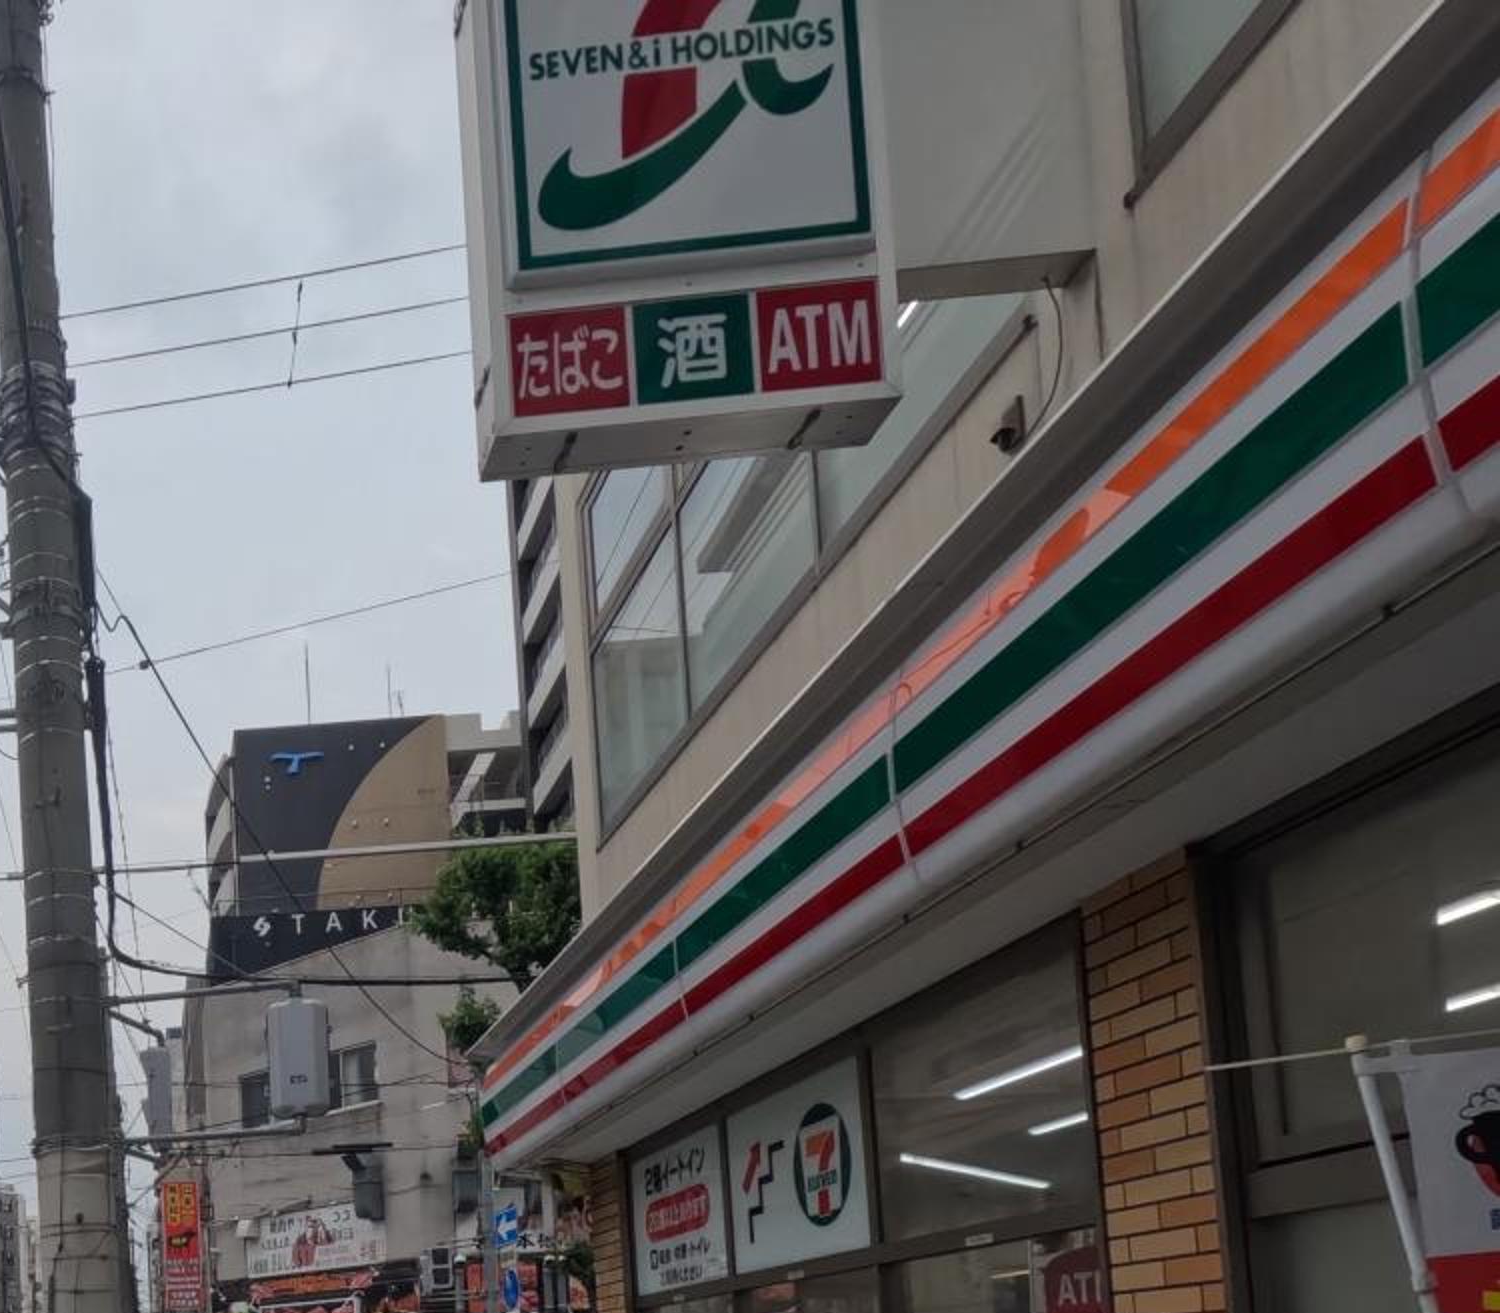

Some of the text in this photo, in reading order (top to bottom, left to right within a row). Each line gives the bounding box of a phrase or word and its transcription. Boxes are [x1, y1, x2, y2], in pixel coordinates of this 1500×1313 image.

[671, 17, 836, 66] HOLDINGS
[515, 299, 873, 400] たばこ 酒 ATM
